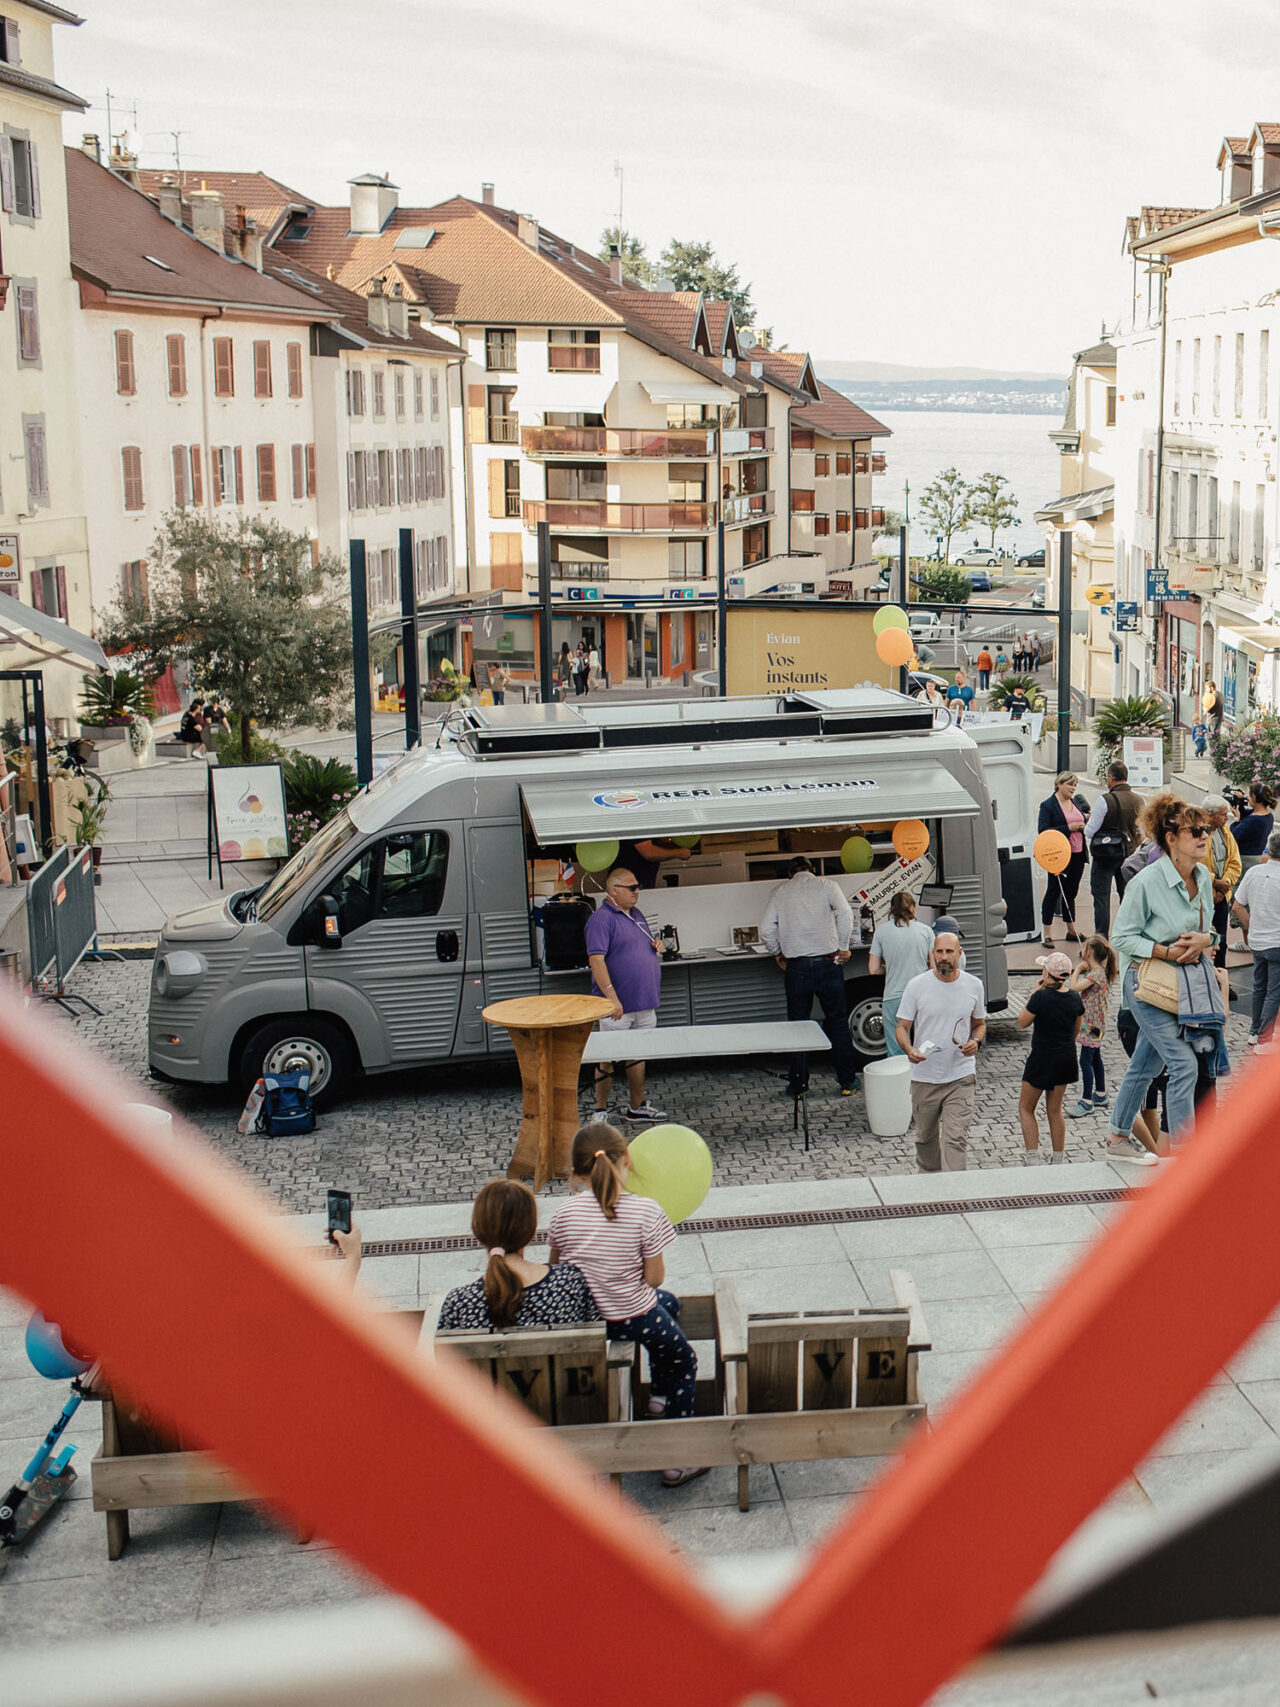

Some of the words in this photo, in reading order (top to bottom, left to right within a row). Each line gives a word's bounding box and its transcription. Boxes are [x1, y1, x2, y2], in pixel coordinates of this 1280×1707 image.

[570, 589, 596, 600] CIC
[671, 589, 692, 599] CIC
[766, 632, 801, 645] Evian
[766, 651, 796, 667] Vos
[766, 669, 828, 684] instants
[651, 788, 711, 800] RER
[868, 879, 900, 907] MAURICE
[900, 861, 923, 881] EVIAN
